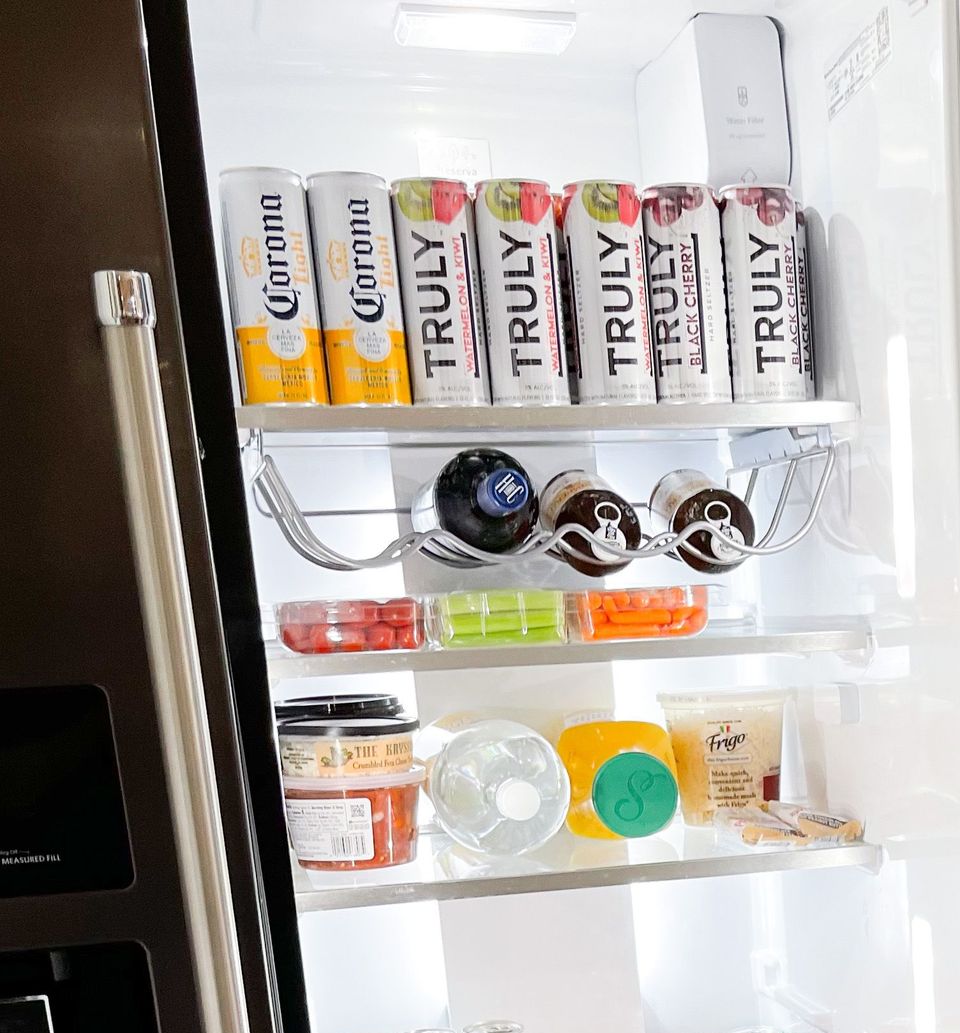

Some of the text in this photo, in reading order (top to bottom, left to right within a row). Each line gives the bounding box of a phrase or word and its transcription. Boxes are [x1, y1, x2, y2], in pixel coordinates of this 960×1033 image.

[260, 193, 301, 320] Corona
[348, 198, 387, 323] Corona
[411, 230, 457, 378] TRULY
[452, 237, 475, 373] WATERMELON & KIWI
[499, 230, 542, 377] TRULY
[538, 237, 559, 372] WATERMELON & KIWI
[597, 230, 638, 377] TRULY
[632, 239, 642, 271] KIWI
[648, 234, 682, 378] TRULY
[680, 243, 702, 368] BLACK CHERRY
[749, 232, 786, 375] TRULY
[783, 244, 800, 367] BLACK CHERRY
[797, 255, 812, 372] BLACK CHERRY
[636, 286, 652, 372] WATERMELON
[354, 745, 378, 759] THE
[706, 732, 746, 752] Frigo
